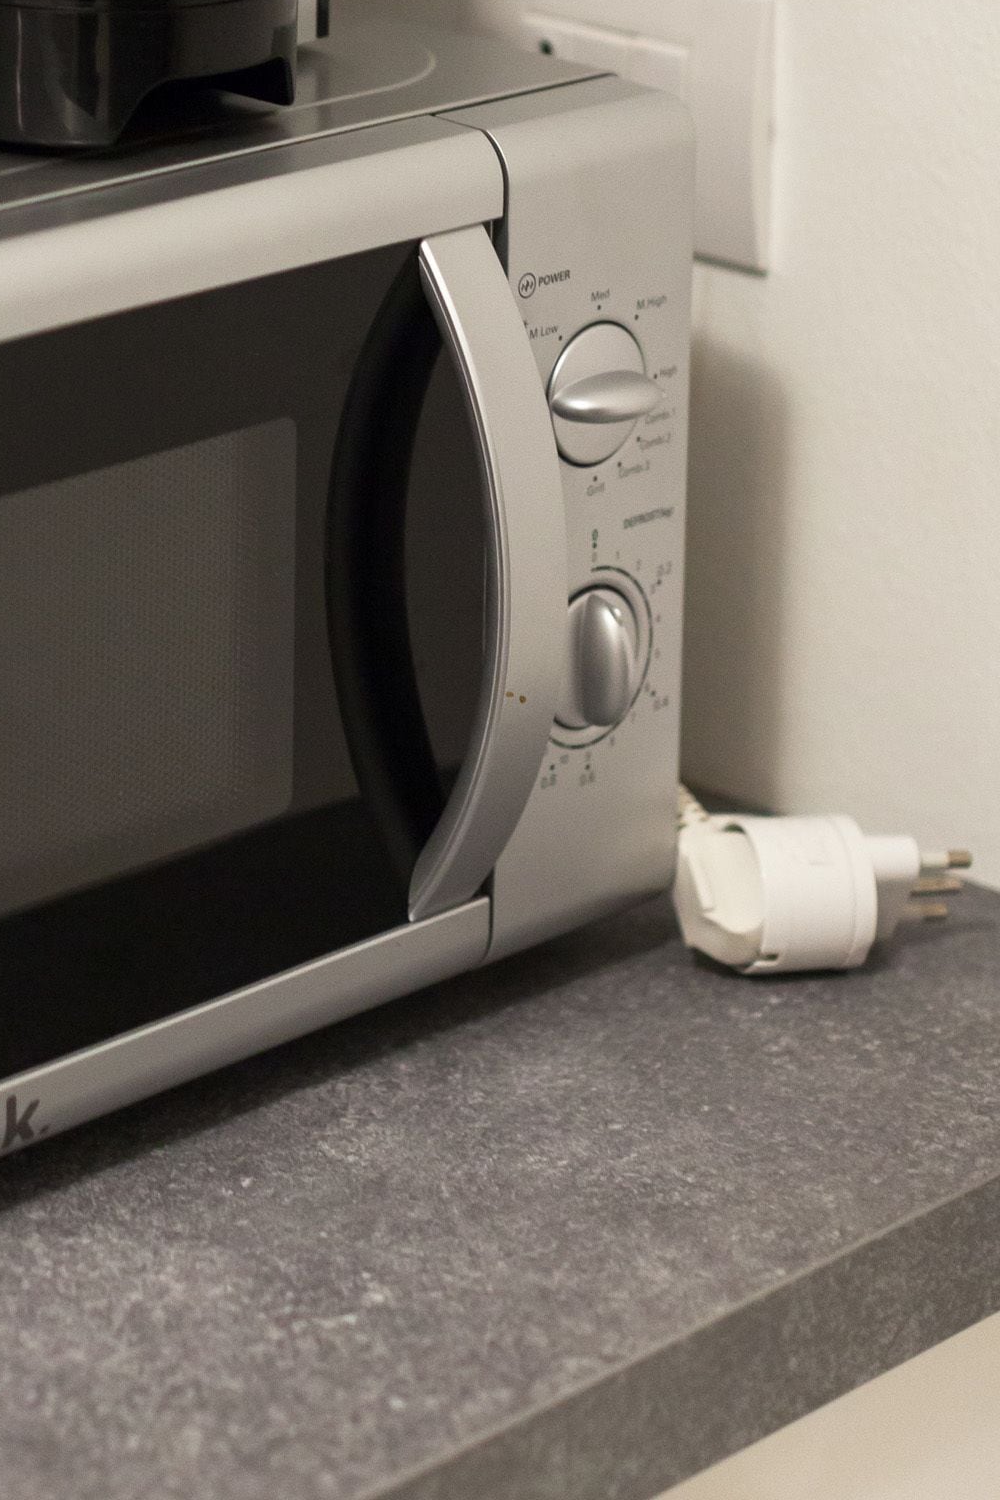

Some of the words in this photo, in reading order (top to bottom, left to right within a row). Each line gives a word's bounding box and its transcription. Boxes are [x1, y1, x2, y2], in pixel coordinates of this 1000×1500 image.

[538, 269, 571, 287] POWER
[591, 289, 610, 301] Med
[529, 329, 539, 340] M
[540, 325, 559, 336] Low
